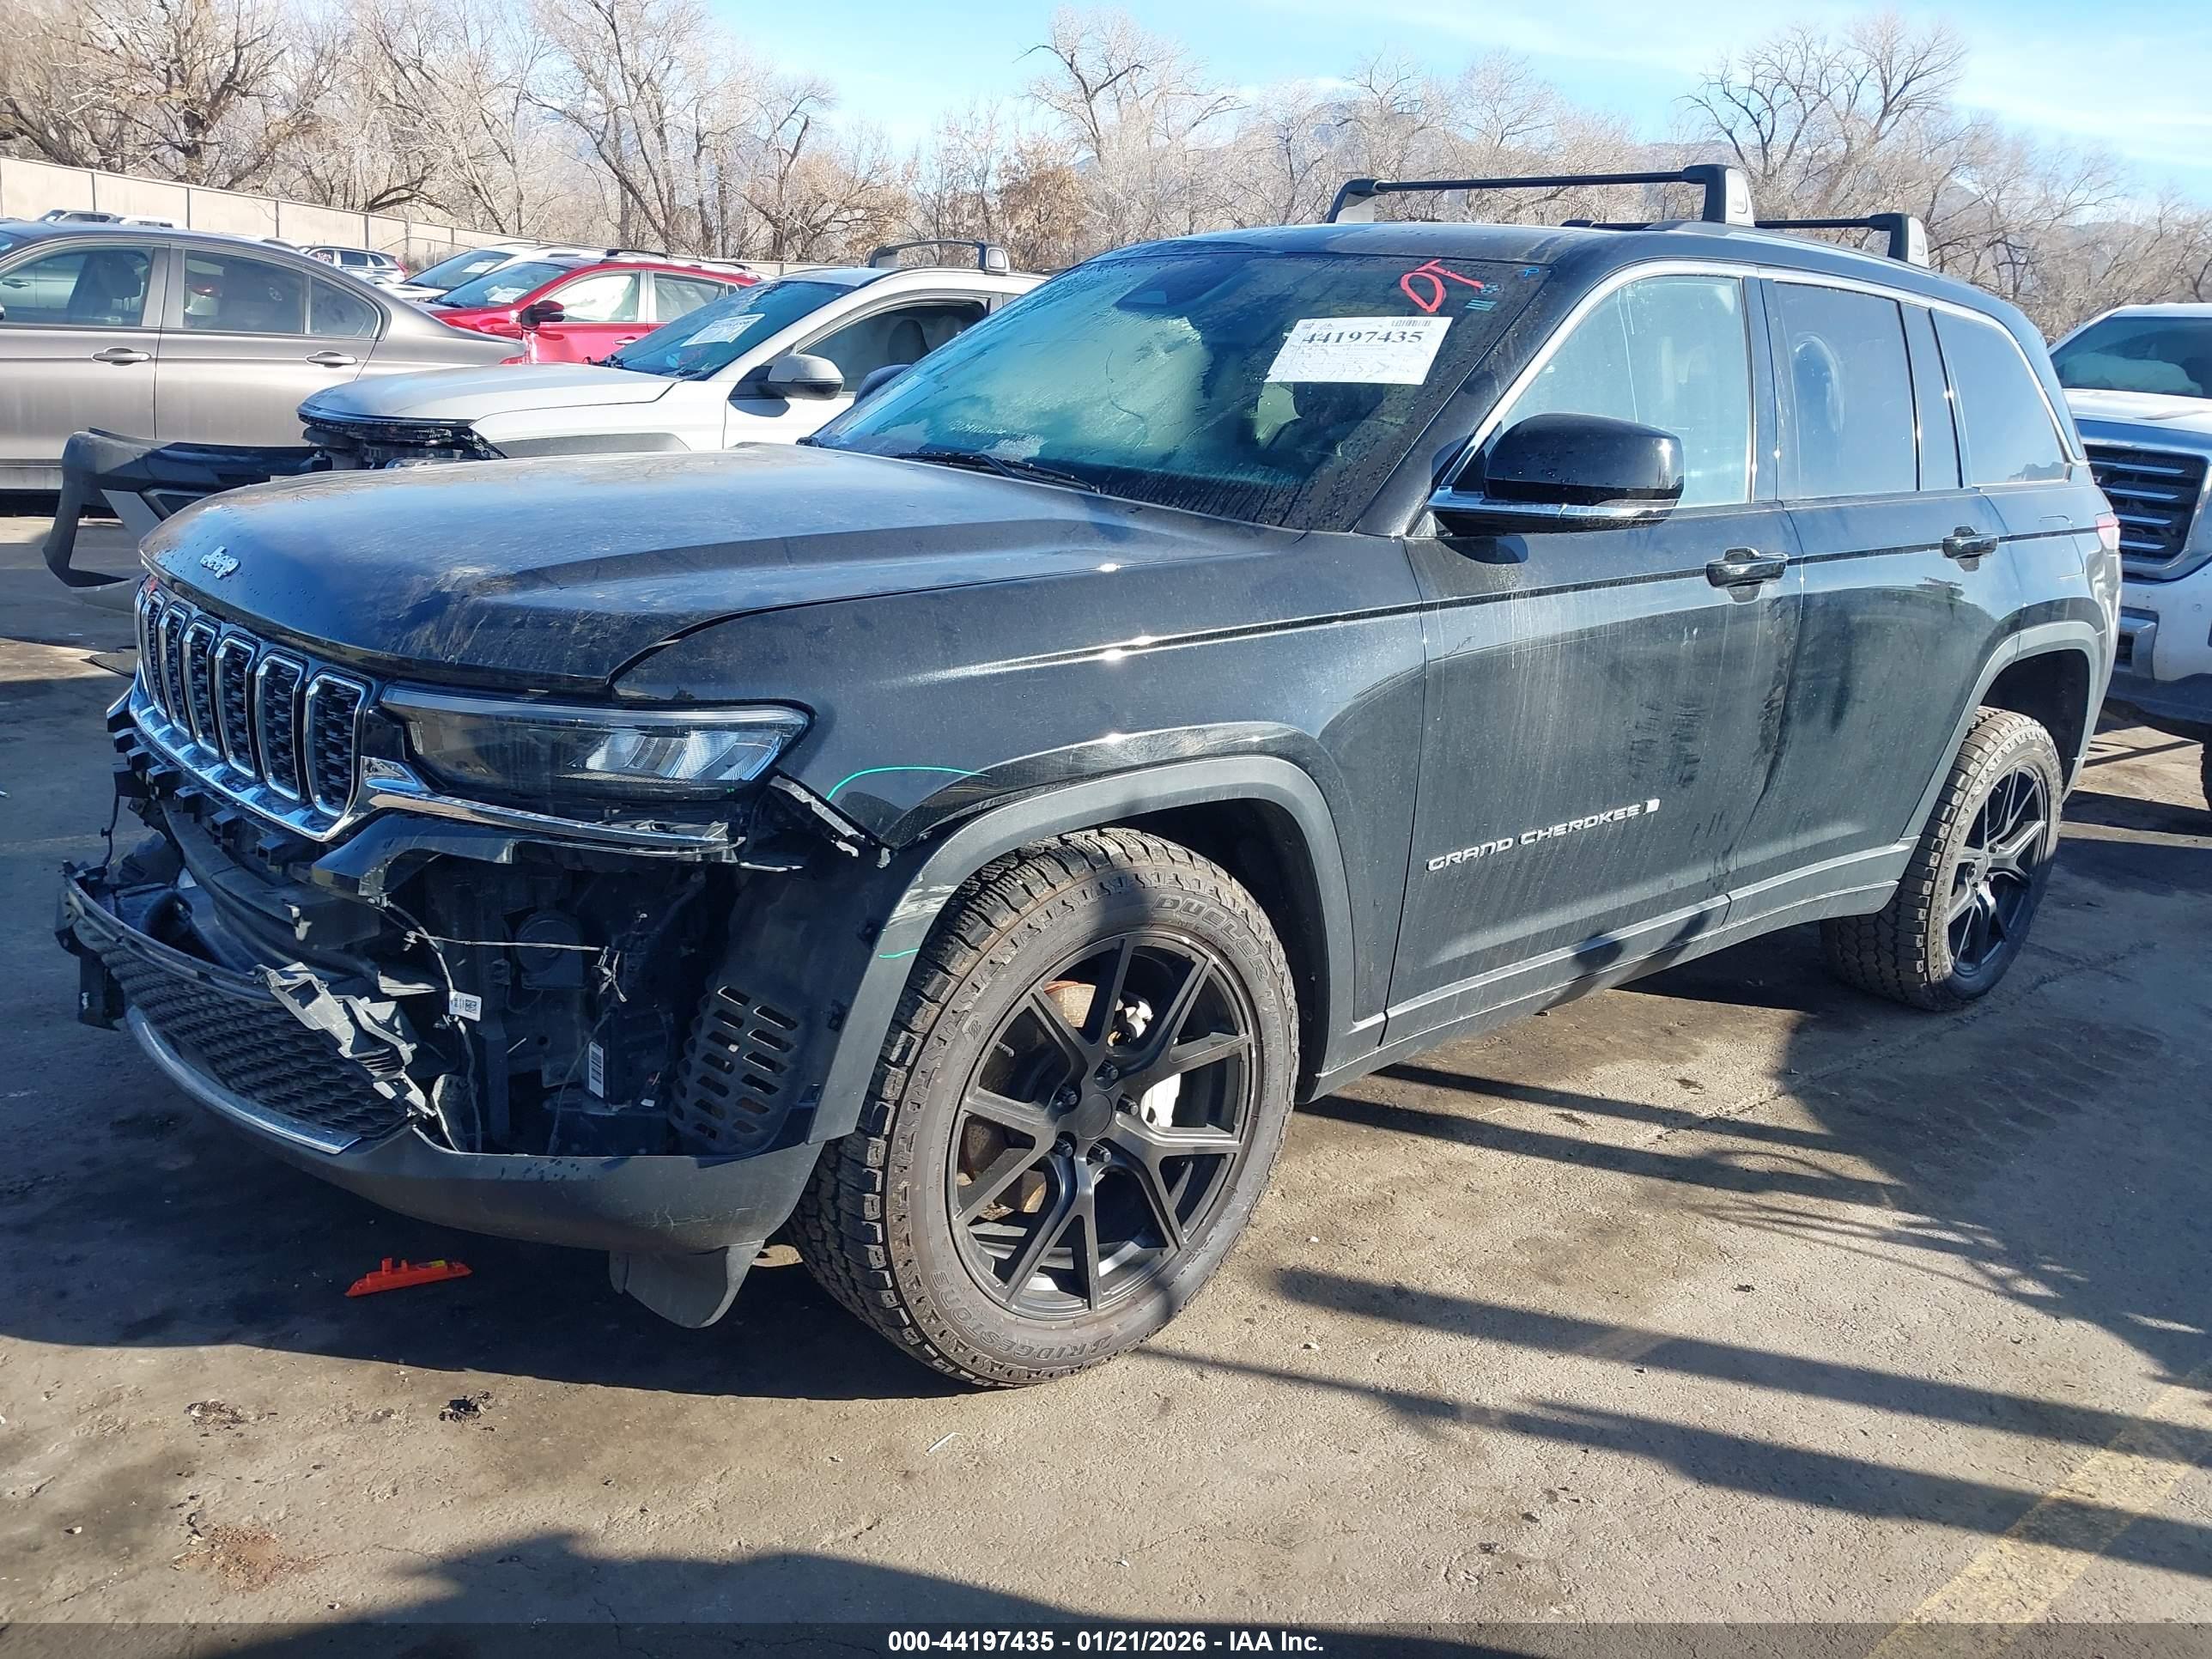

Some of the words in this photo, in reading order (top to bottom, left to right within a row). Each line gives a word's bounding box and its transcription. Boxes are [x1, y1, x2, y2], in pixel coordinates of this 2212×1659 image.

[1302, 331, 1425, 343] 44197435
[199, 545, 240, 580] Jeep
[1426, 836, 1514, 872] GRAND
[1519, 803, 1642, 846] CHEROKEE
[1152, 893, 1270, 981] DUELER
[929, 1270, 1115, 1362] BRIDGESTONE
